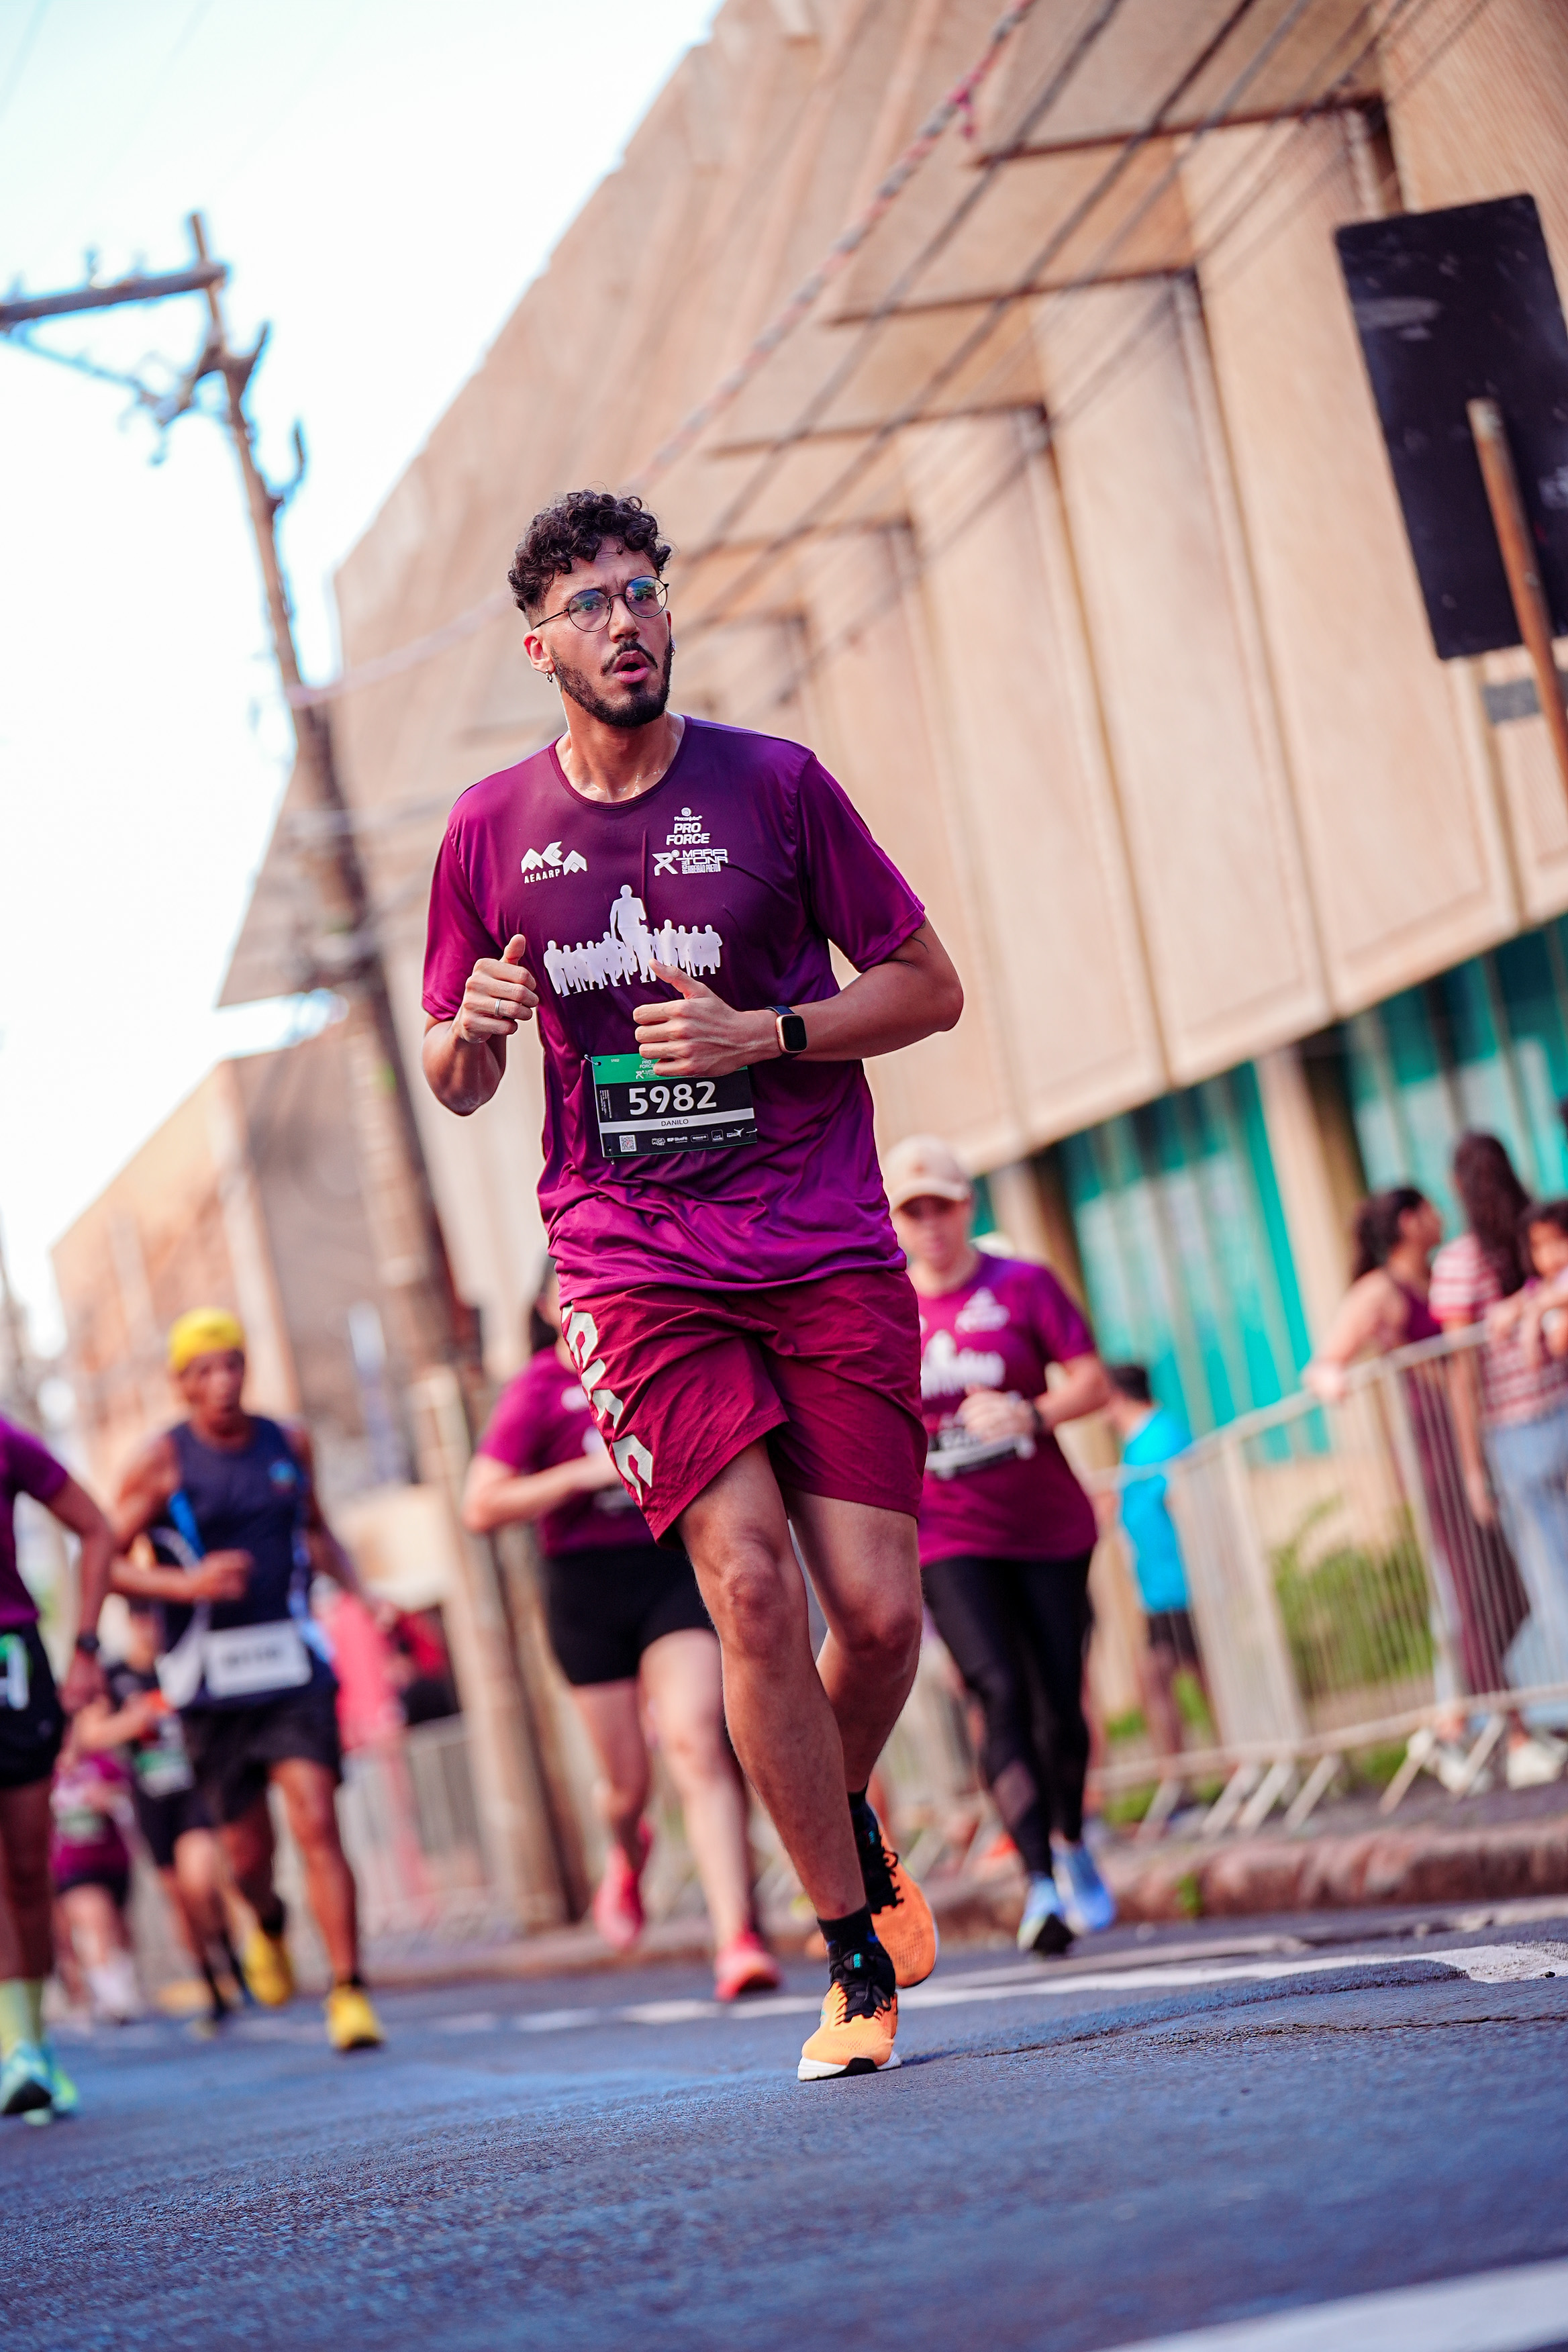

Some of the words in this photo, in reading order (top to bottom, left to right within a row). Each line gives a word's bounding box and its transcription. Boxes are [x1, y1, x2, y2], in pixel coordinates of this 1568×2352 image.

[674, 822, 701, 834] PRO
[666, 833, 710, 845] FORCE
[682, 848, 728, 858] MARA
[524, 869, 560, 883] AEAARP
[629, 1081, 717, 1115] 5982
